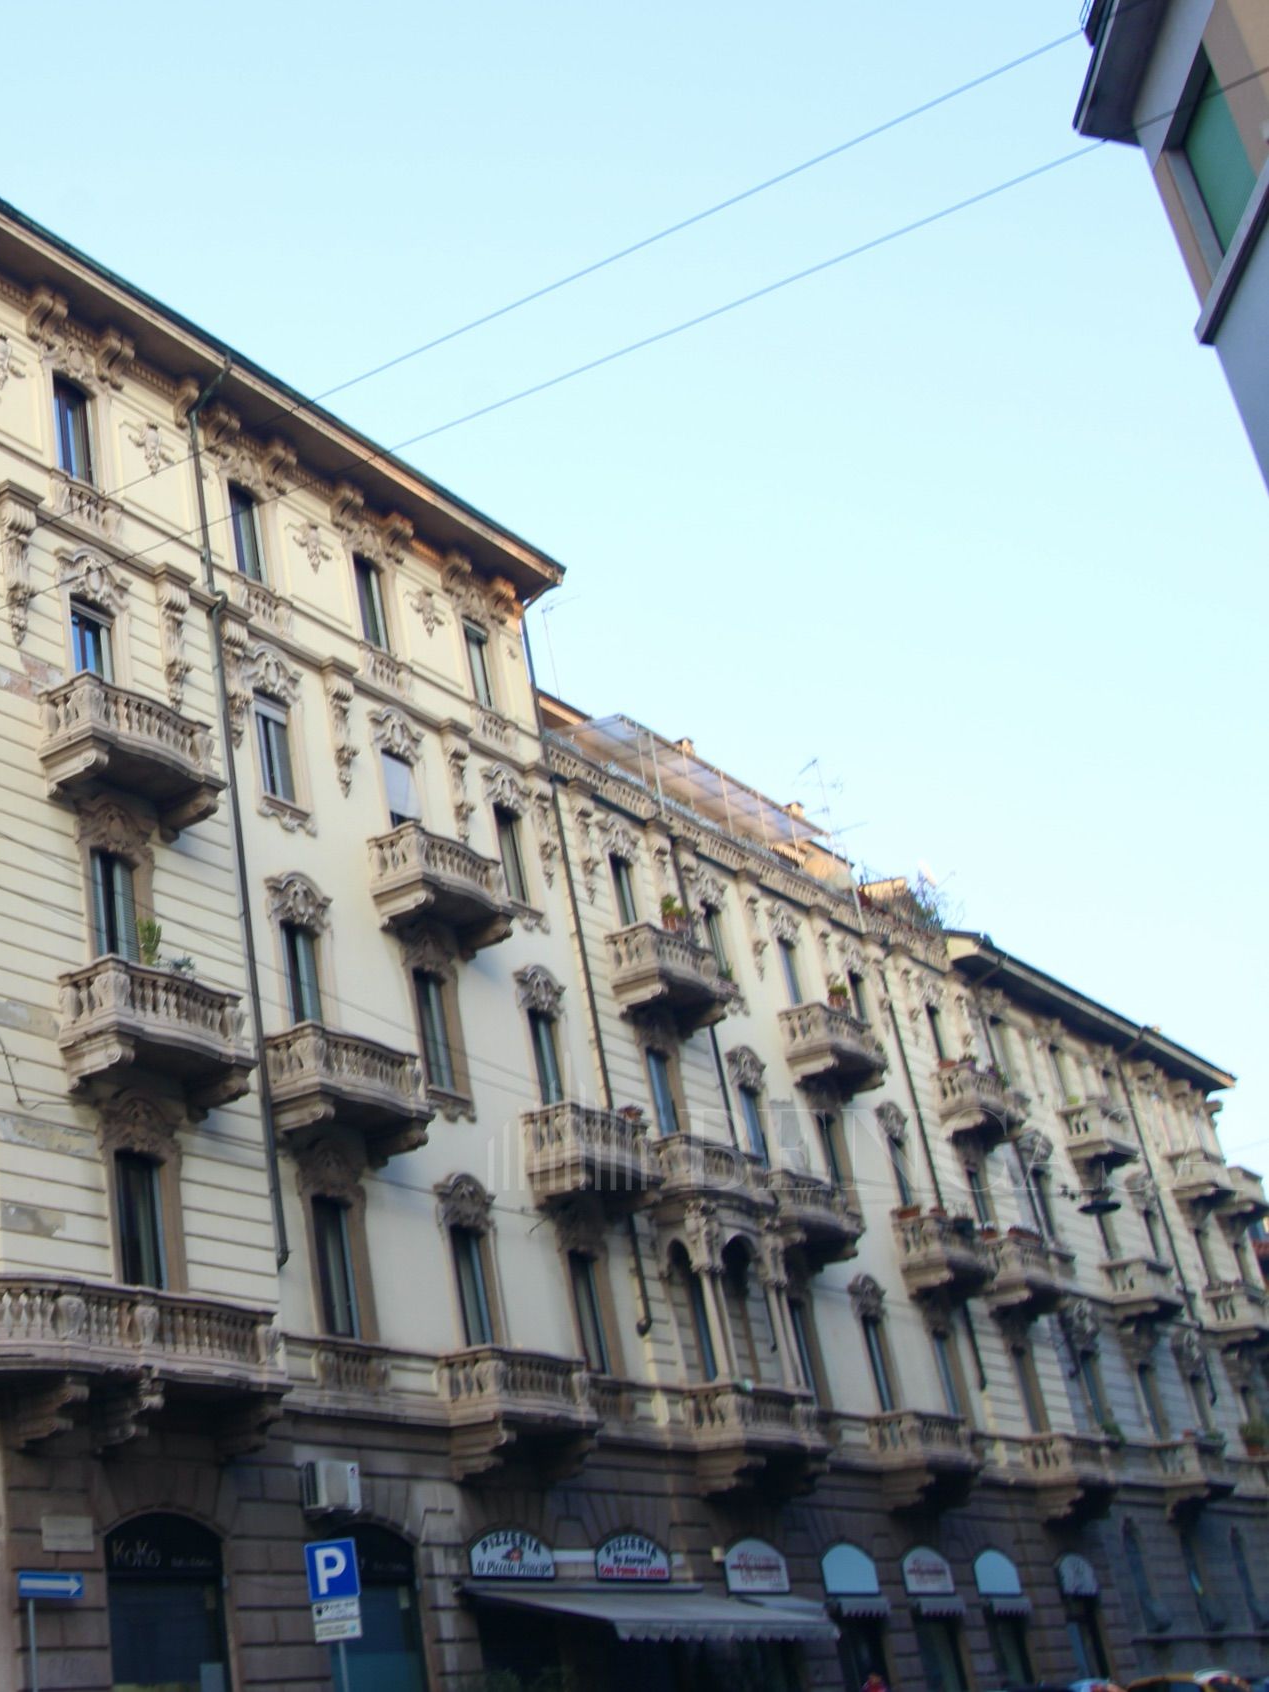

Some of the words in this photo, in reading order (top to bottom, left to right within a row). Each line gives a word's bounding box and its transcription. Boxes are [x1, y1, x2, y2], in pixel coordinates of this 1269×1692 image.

[479, 1530, 542, 1556] PIZZERIA
[604, 1535, 658, 1560] PIZZERIA
[314, 1547, 347, 1596] P
